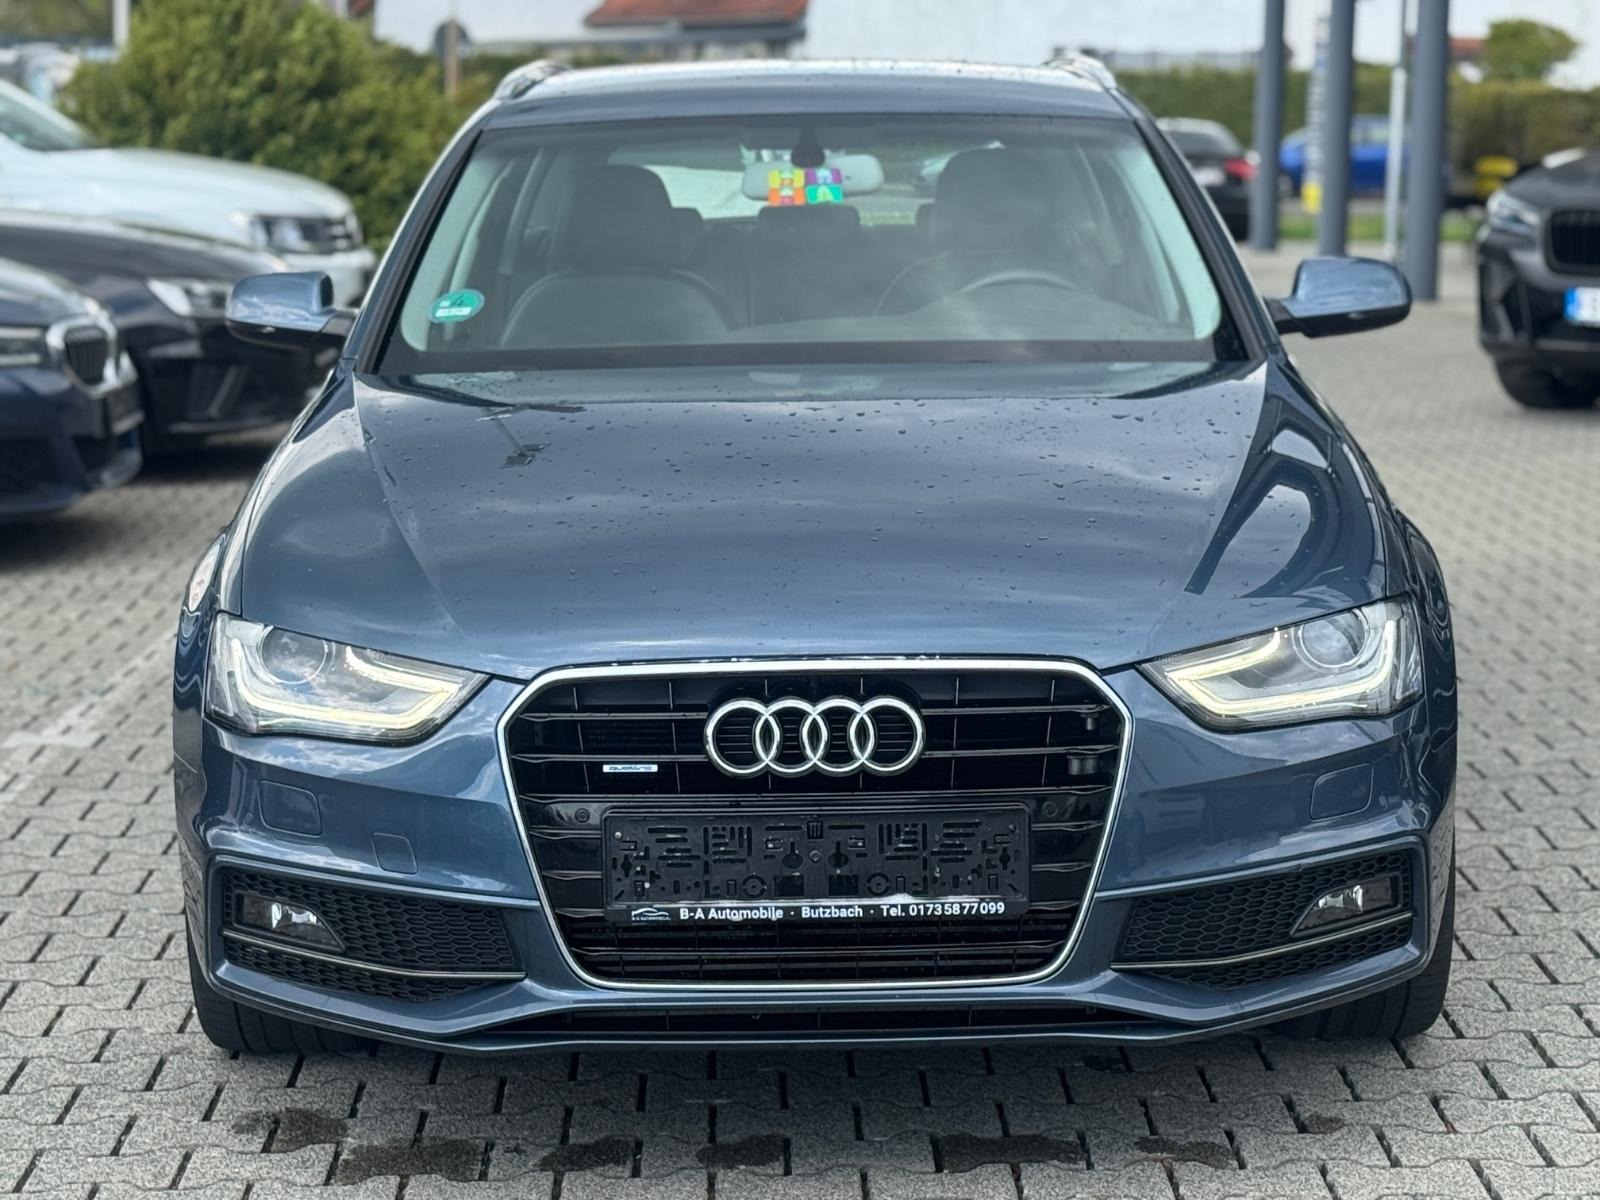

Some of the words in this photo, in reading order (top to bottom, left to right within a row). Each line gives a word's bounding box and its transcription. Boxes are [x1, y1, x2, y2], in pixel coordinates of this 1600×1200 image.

[680, 908, 705, 920] B-A
[708, 907, 783, 920] Automobile
[801, 905, 863, 918] Butzbach
[880, 905, 905, 916] Tel.
[909, 902, 1005, 916] 01735877099
